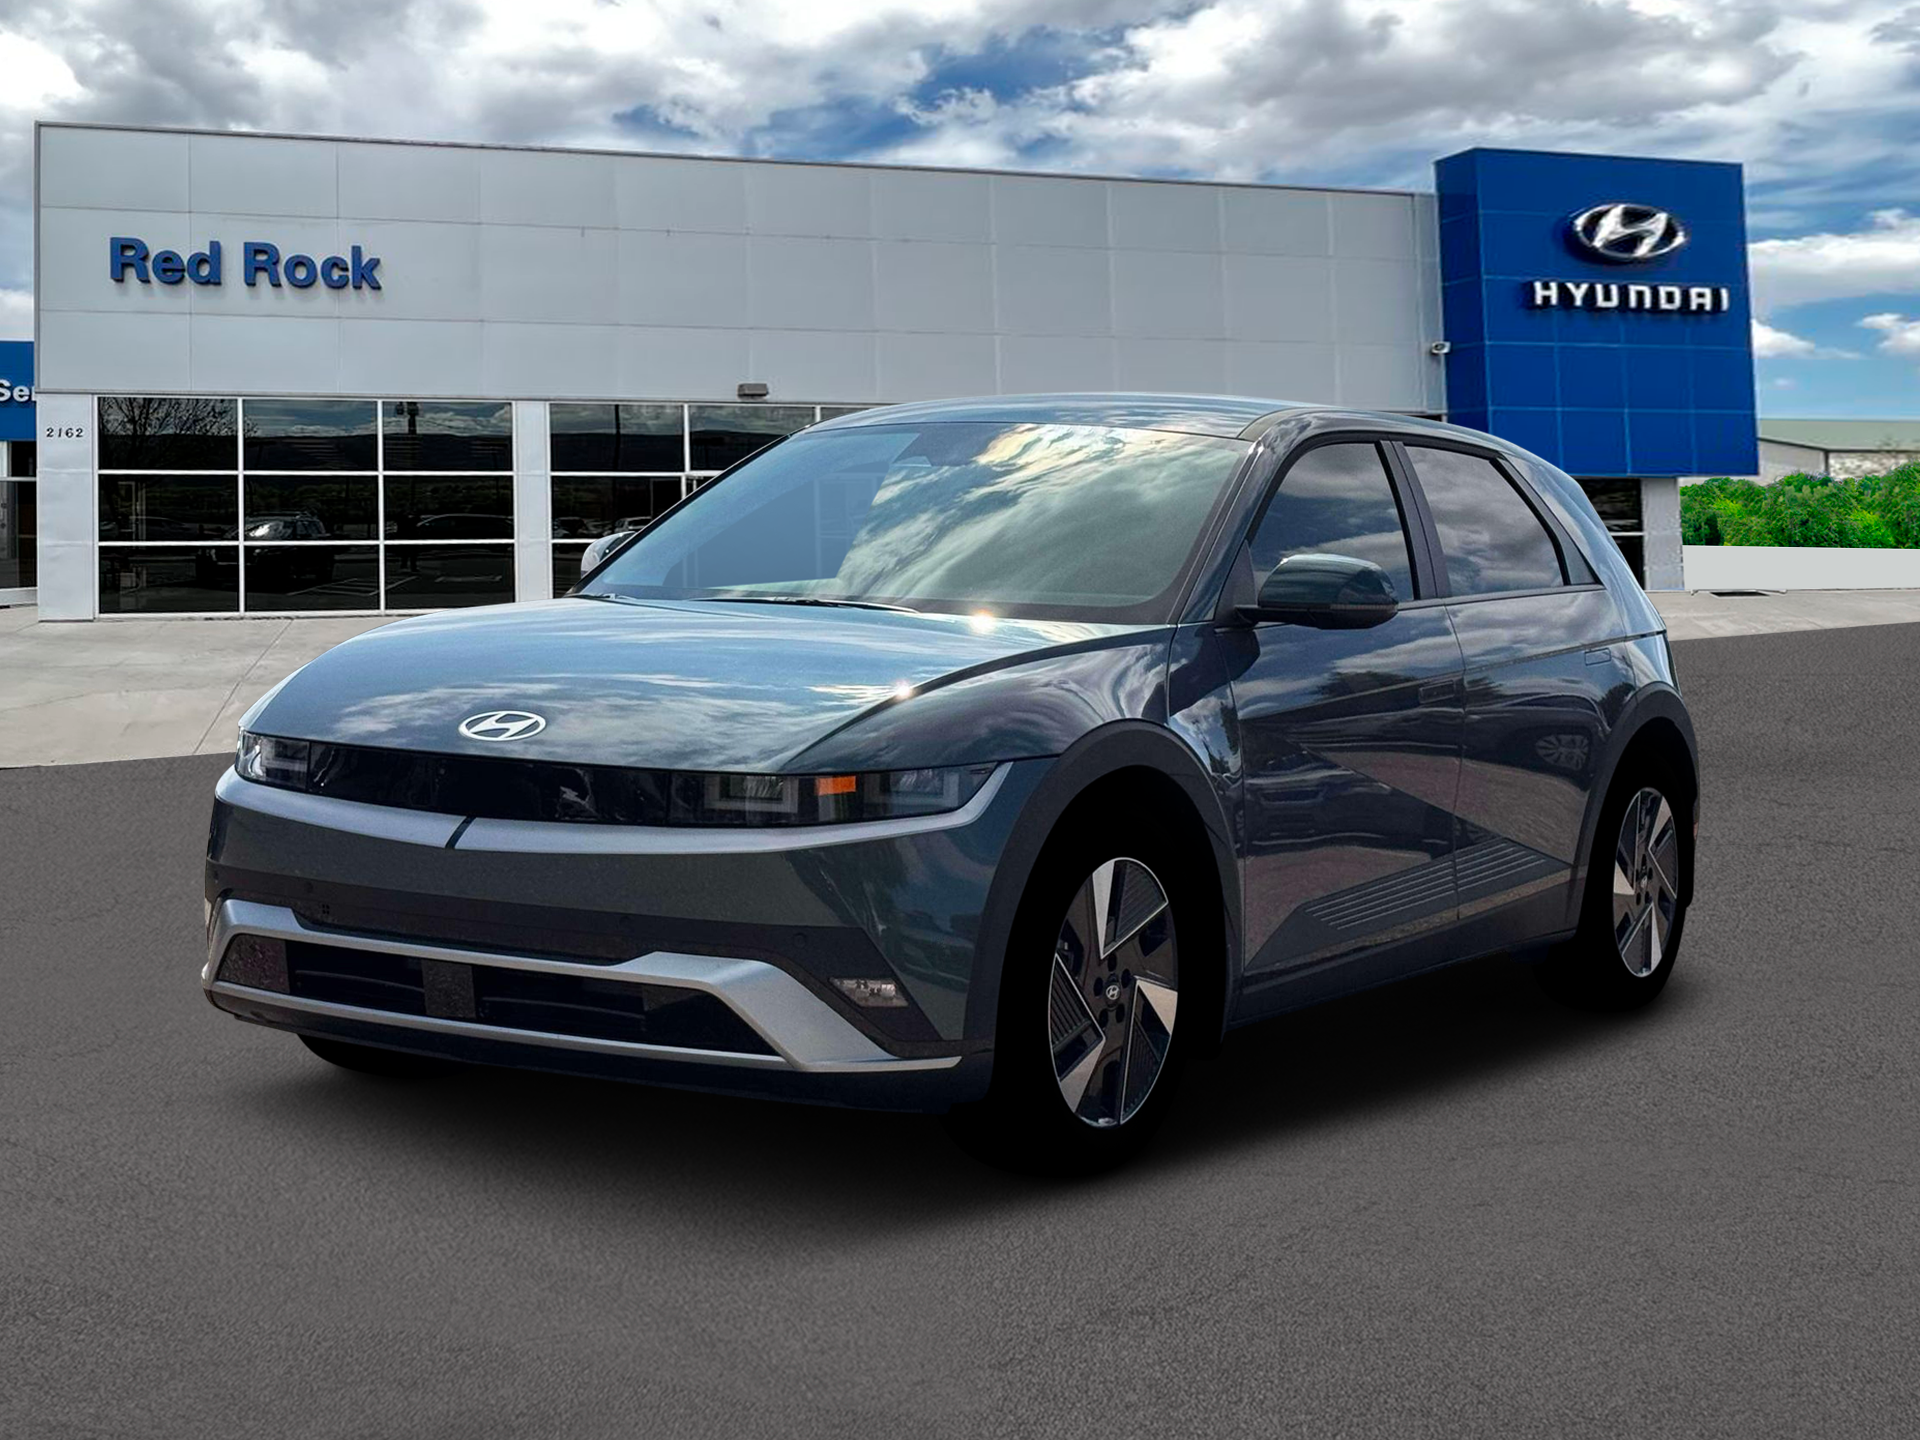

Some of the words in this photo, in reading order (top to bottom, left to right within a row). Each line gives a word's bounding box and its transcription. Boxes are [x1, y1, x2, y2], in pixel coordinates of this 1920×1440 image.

[110, 237, 222, 285] Red
[243, 242, 382, 290] Rock
[1533, 281, 1730, 311] HYUNDAI
[46, 427, 84, 438] 2162
